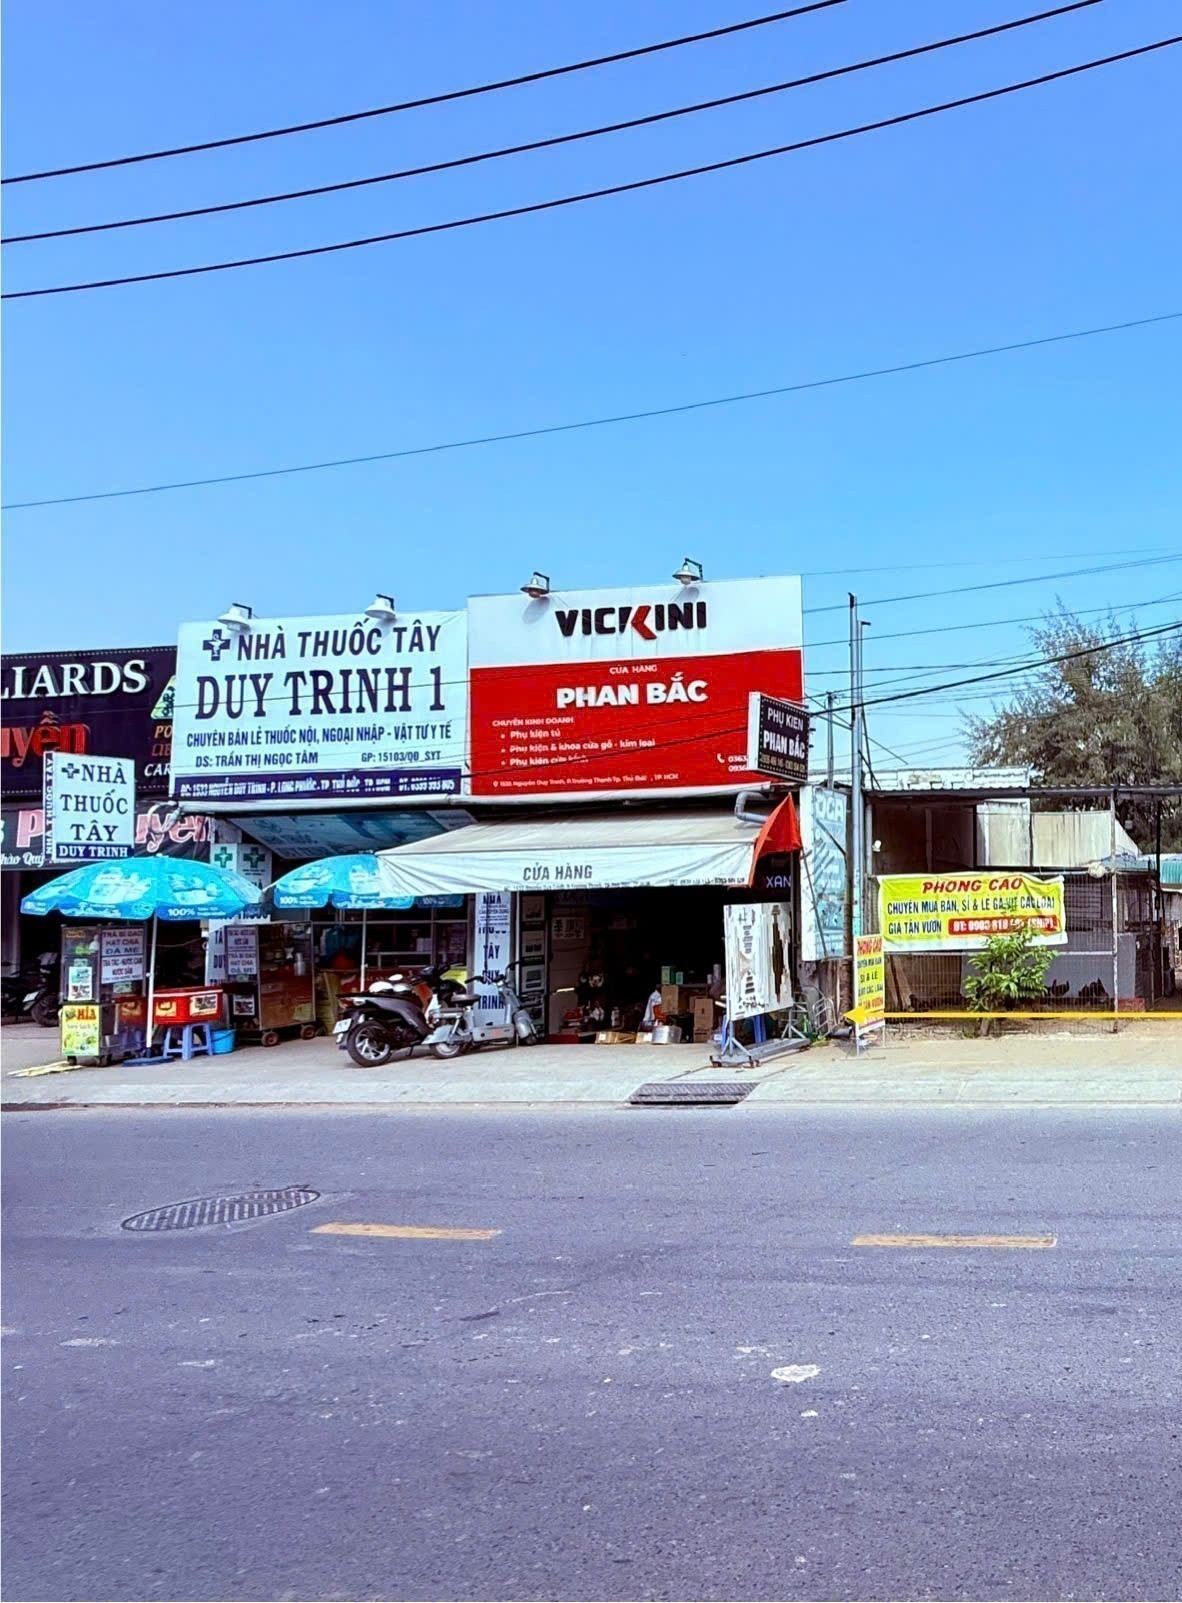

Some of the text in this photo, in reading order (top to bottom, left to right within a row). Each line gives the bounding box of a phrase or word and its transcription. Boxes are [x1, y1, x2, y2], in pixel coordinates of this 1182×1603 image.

[555, 601, 707, 640] VICKINI
[237, 618, 441, 661] NHÀ THUỐC TÂY
[1, 660, 148, 699] IARDS
[195, 666, 445, 719] DUY TRINH 1
[557, 672, 709, 709] PHAN BẮC
[525, 718, 544, 726] KINH
[546, 716, 574, 725] DOANH
[768, 707, 784, 728] PHỤ
[187, 729, 226, 748] CHUYÊN
[228, 728, 249, 746] BÁN
[251, 725, 263, 745] LẺ
[265, 724, 297, 744] THUỐC
[299, 725, 320, 747] NỘI,
[322, 726, 354, 745] NGOẠI
[356, 723, 385, 744] NHẬP
[394, 722, 412, 743] VẬT
[440, 719, 452, 739] TẾ
[510, 731, 527, 740] Phụ
[529, 730, 549, 739] kiện
[620, 738, 638, 748] kim
[763, 730, 788, 755] PHAN
[195, 755, 213, 768] DS:
[245, 754, 261, 769] THỊ
[264, 752, 293, 767] NGỌC
[296, 749, 319, 765] TÂM
[82, 762, 127, 785] NHÀ
[60, 790, 128, 814] THUỐC
[70, 820, 119, 841] TÂY
[59, 845, 128, 857] DUY TRINH
[523, 862, 593, 881] CỬA HÀNG
[922, 877, 1023, 894] PHONG CAO
[167, 906, 196, 918] 100%
[921, 900, 938, 914] MUA
[972, 899, 979, 911] &
